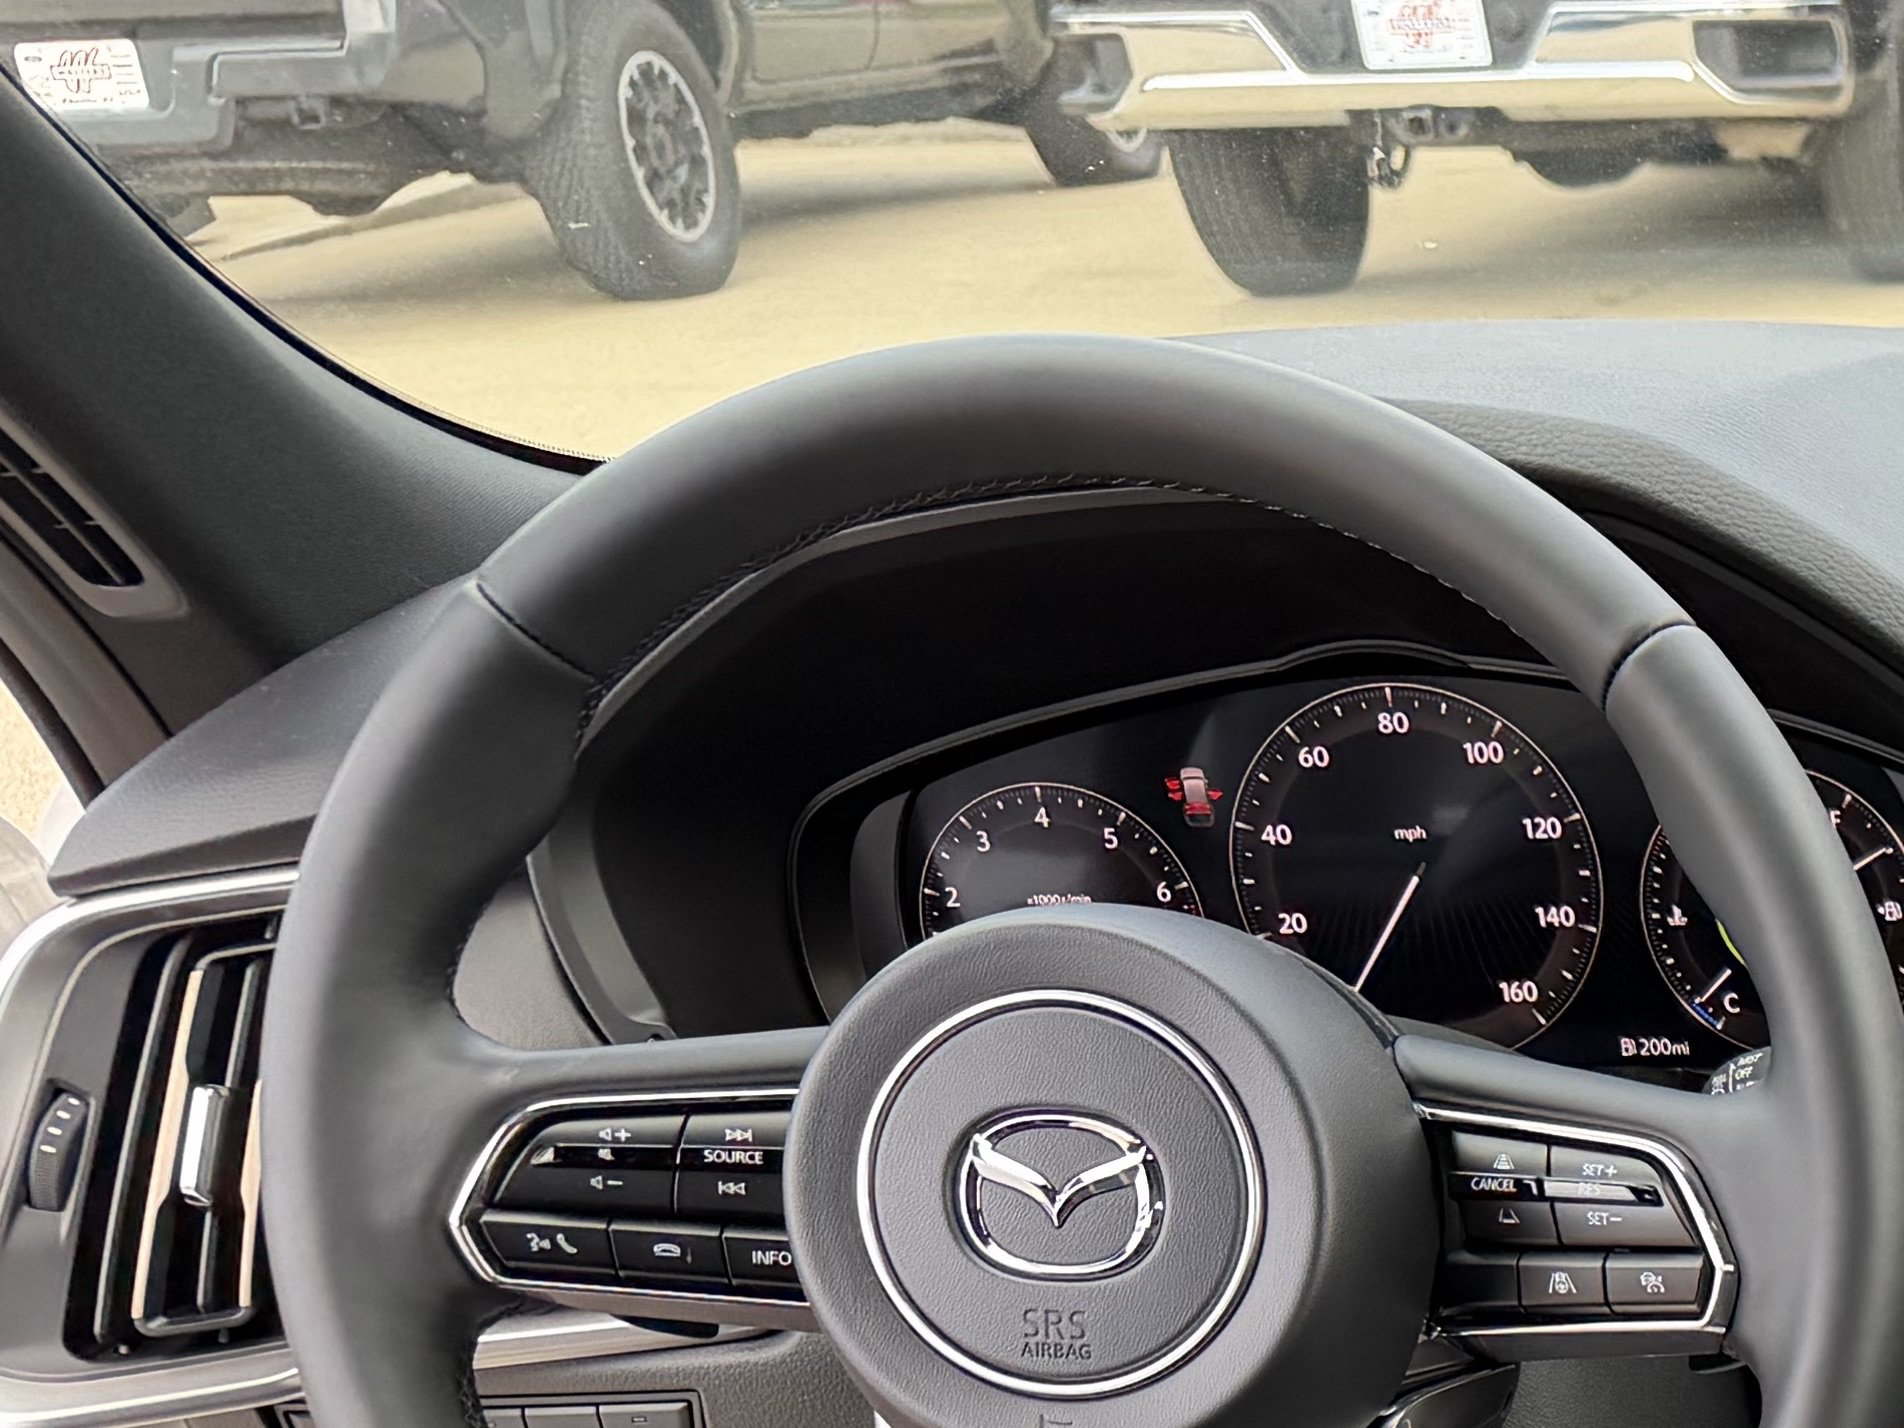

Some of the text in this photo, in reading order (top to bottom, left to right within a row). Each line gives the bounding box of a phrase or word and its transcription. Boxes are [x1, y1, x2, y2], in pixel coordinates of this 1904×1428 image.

[1377, 712, 1410, 734] 80
[1298, 746, 1330, 769] 60
[1462, 742, 1504, 765] 100
[1034, 806, 1050, 827] 4
[1104, 827, 1119, 850] 5
[1260, 823, 1293, 846] 40
[1394, 828, 1427, 842] mph
[1521, 817, 1562, 840] 120
[976, 830, 991, 852] 3
[945, 886, 961, 908] 2
[1156, 882, 1172, 903] 6
[1278, 912, 1308, 935] 20
[1533, 906, 1576, 930] 140
[1498, 980, 1539, 1004] 160
[1723, 992, 1740, 1014] C
[703, 1149, 764, 1166] SOURCE
[1471, 1178, 1517, 1193] CANCEL
[752, 1250, 792, 1266] INFO
[1023, 1308, 1087, 1341] SRS
[1021, 1341, 1092, 1361] AIRBAG
